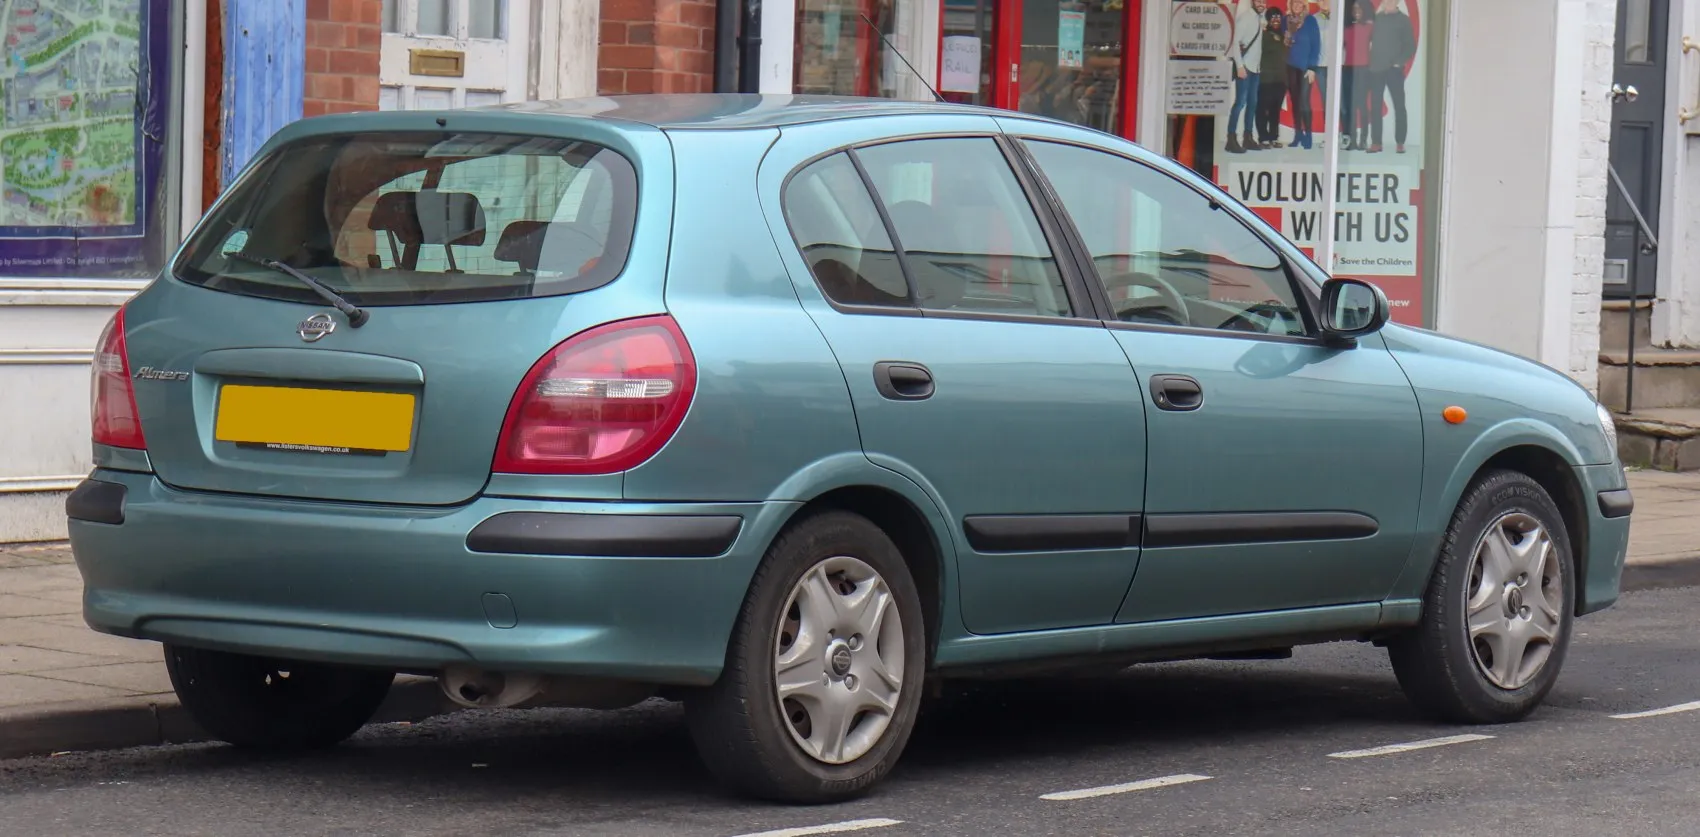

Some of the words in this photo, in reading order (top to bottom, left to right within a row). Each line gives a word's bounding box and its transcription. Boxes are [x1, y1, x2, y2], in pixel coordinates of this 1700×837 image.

[1238, 171, 1400, 204] VOLUNTEER
[1374, 212, 1409, 243] US
[1340, 257, 1360, 266] Save
[1361, 257, 1376, 266] the
[1376, 257, 1413, 267] Children
[1387, 299, 1410, 307] new
[300, 320, 330, 330] NISSAN
[133, 366, 189, 381] Almera
